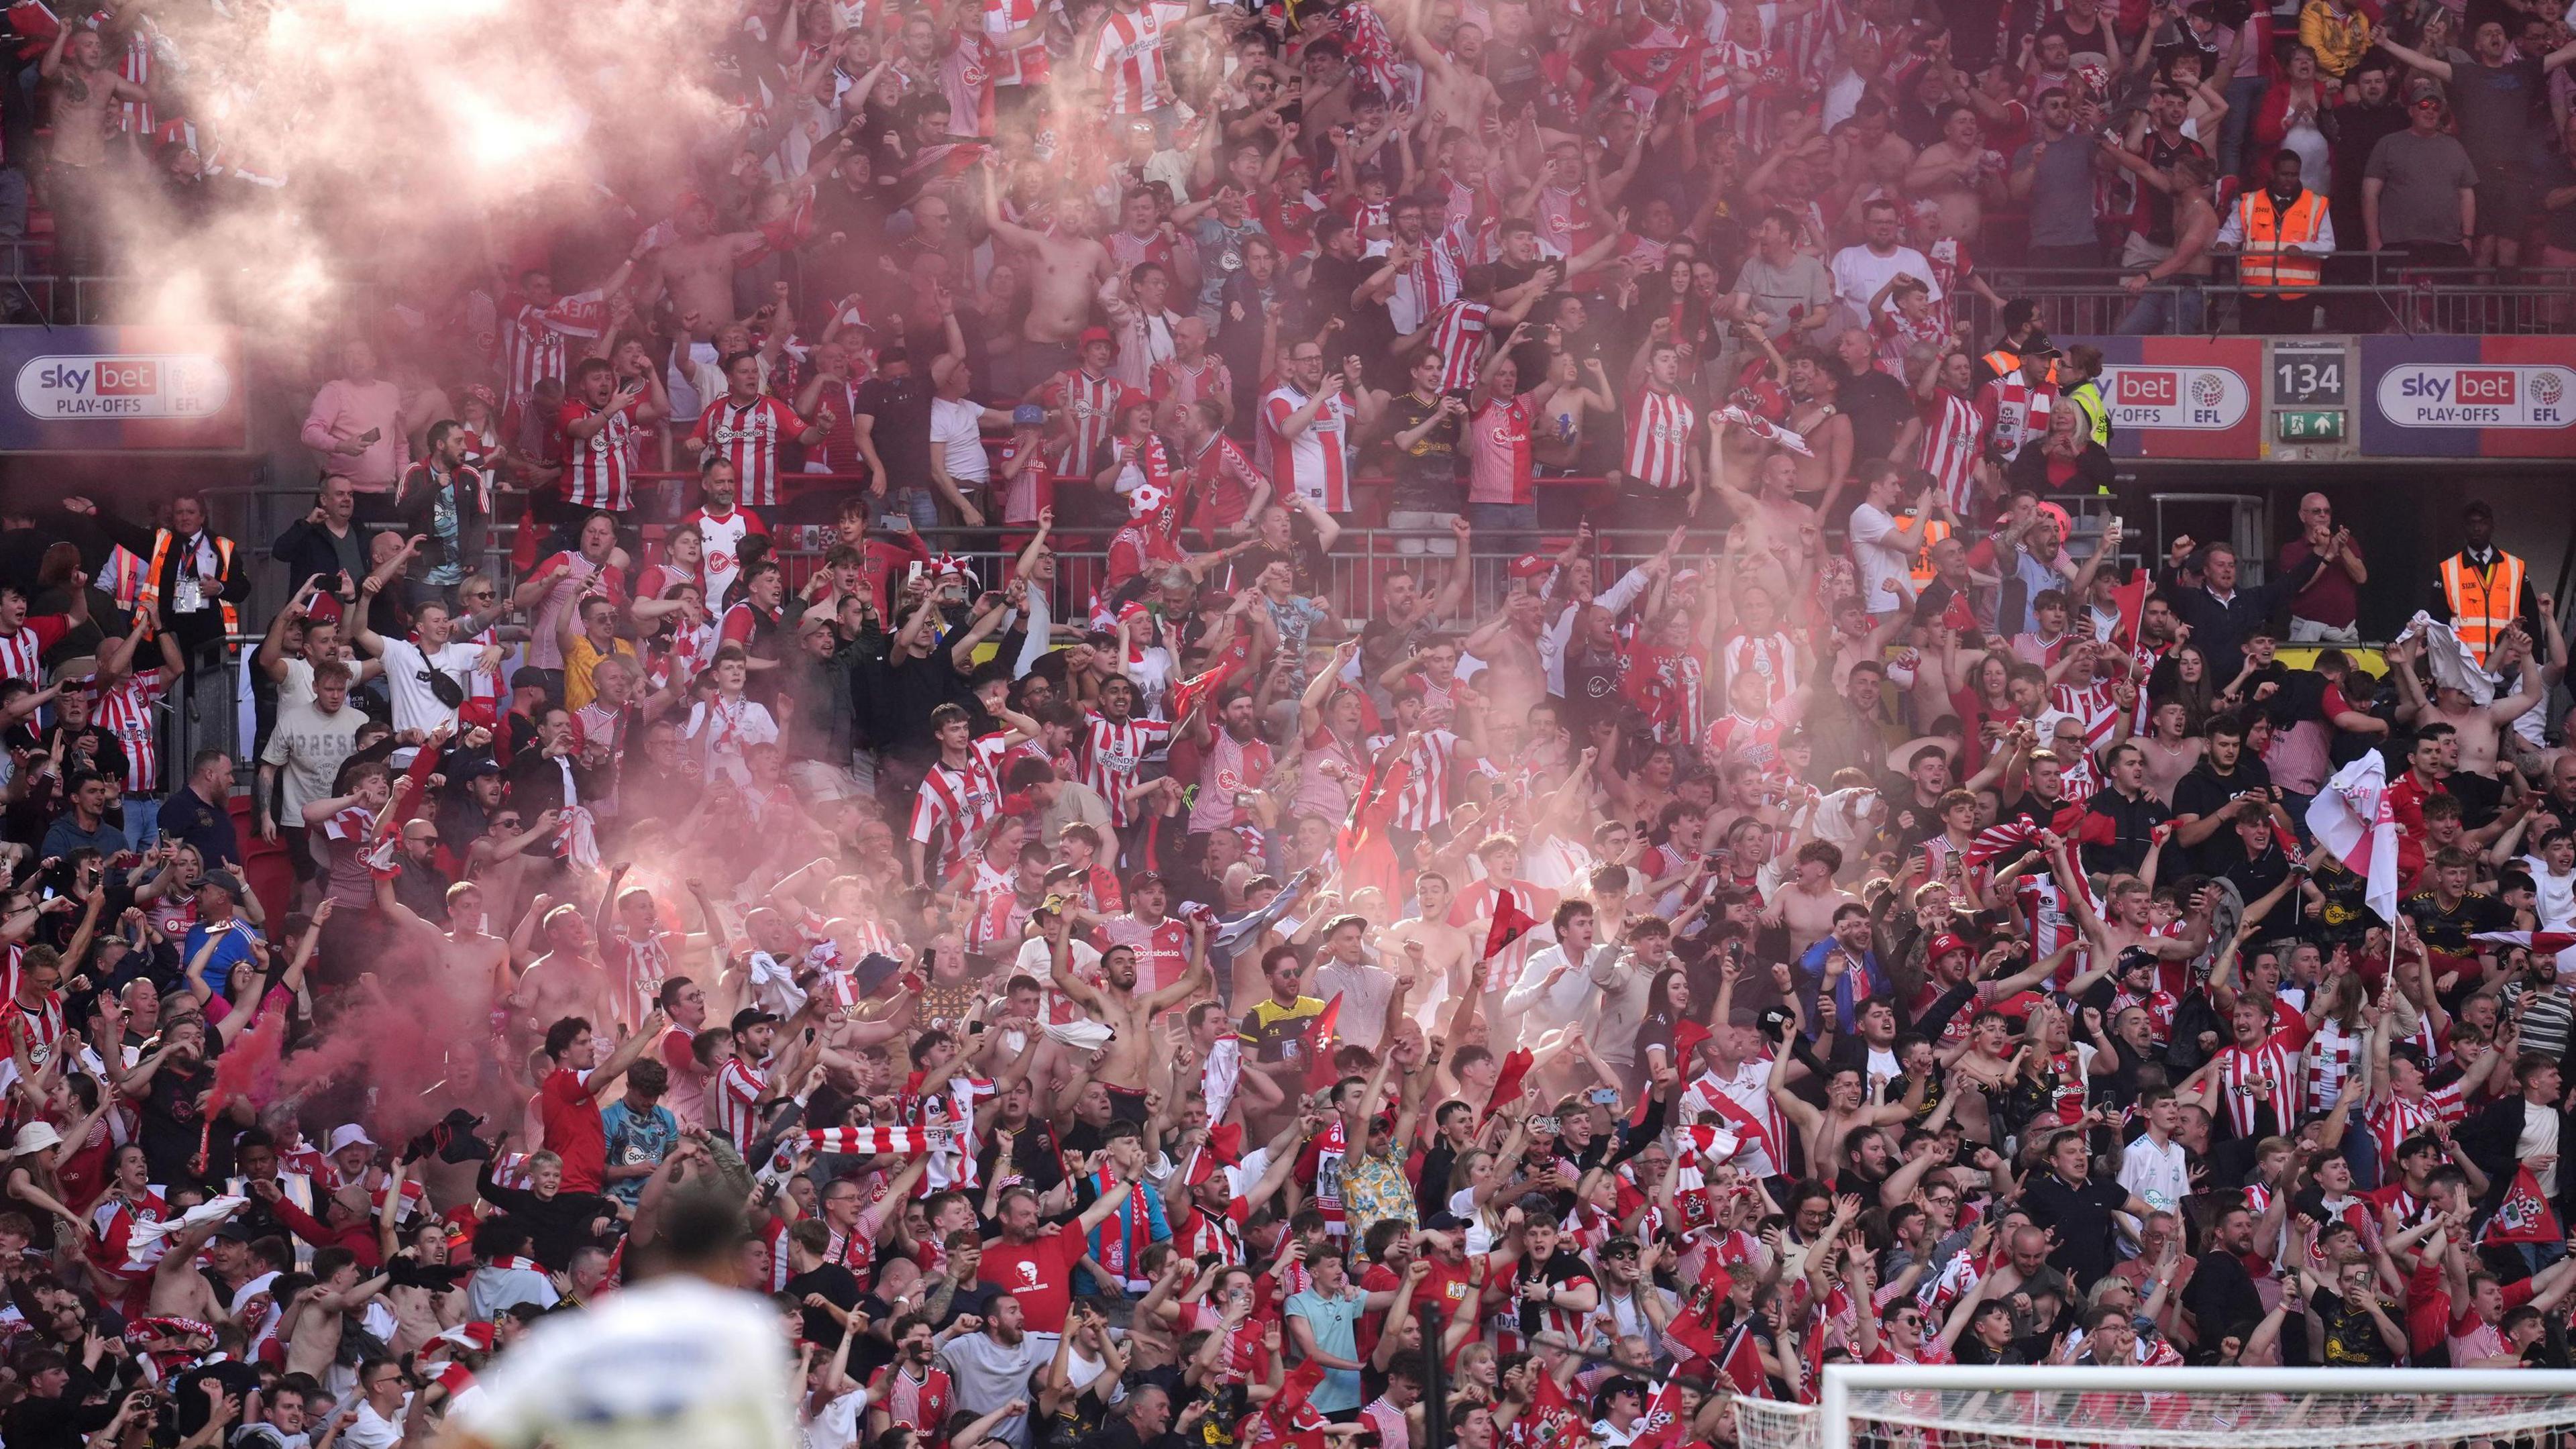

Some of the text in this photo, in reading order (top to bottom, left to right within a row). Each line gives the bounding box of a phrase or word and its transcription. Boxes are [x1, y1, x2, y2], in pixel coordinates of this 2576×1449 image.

[41, 364, 150, 394] sky bet
[2278, 364, 2342, 394] 134
[2123, 376, 2171, 399] bet
[2402, 372, 2509, 402] sky bet
[57, 399, 141, 413] PLAY-OFFS
[176, 398, 204, 411] EFL
[2194, 410, 2220, 423] EFL
[2418, 409, 2500, 422] PLAY-OFFS
[2534, 409, 2560, 421] EFL
[2231, 1079, 2275, 1097] veo
[1497, 1313, 1519, 1328] flyb
